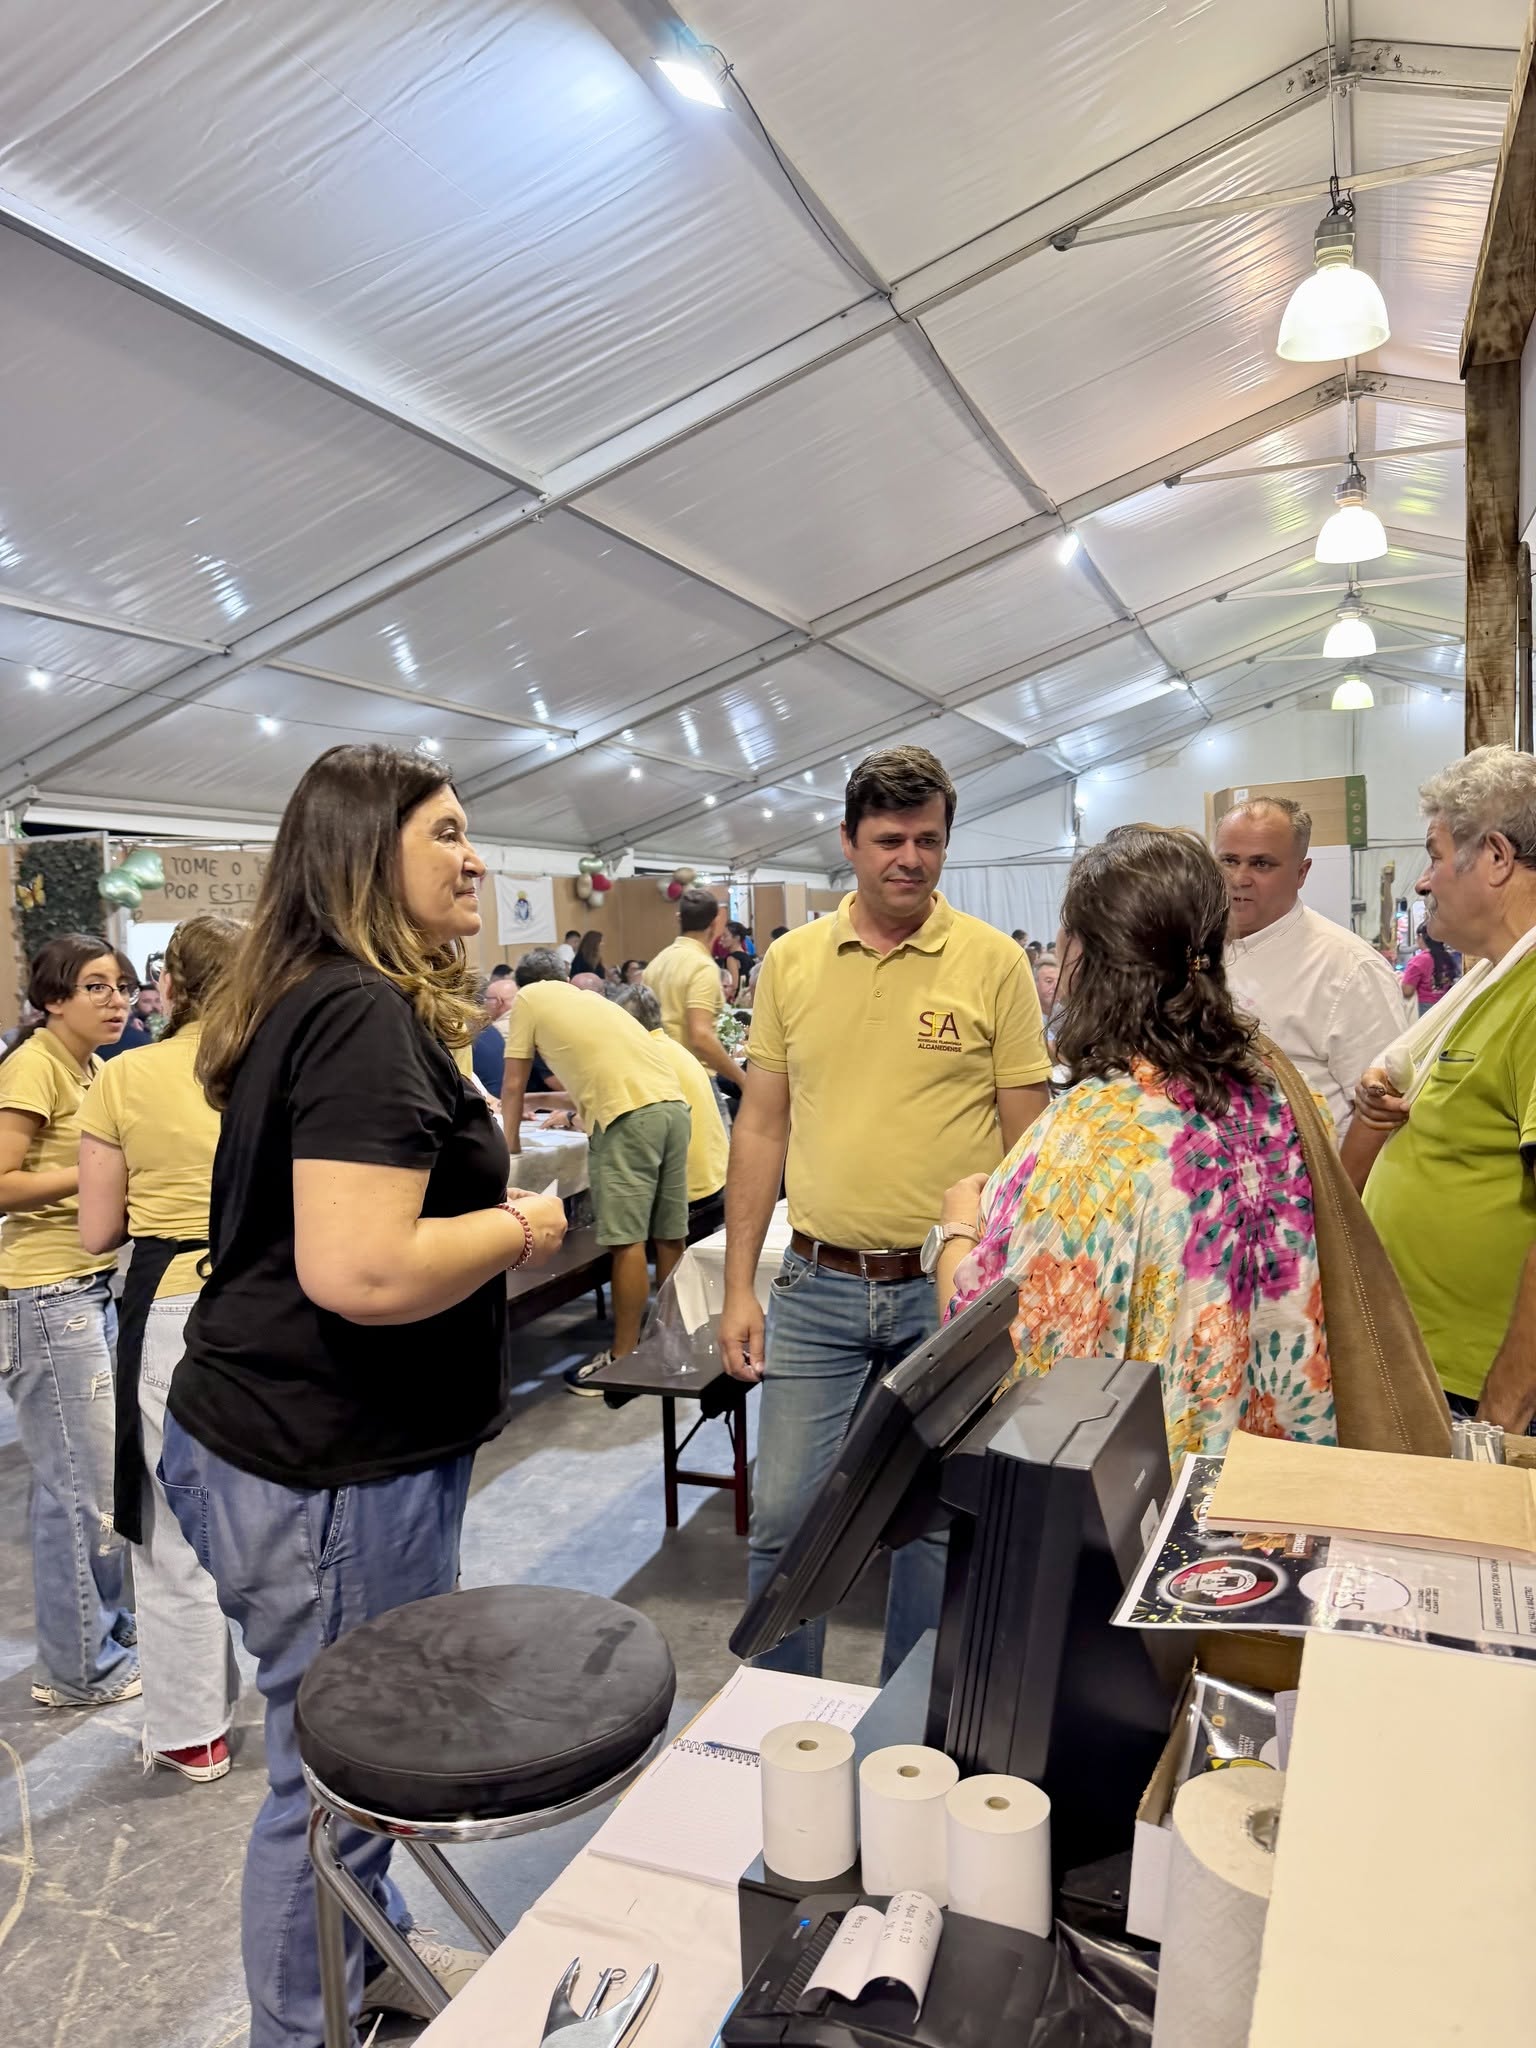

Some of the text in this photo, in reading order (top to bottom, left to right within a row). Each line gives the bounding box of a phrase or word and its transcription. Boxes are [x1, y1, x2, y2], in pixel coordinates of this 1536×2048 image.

[171, 856, 219, 877] TOME
[231, 861, 242, 876] O
[164, 882, 200, 899] POR
[918, 1043, 962, 1052] ALCANEDENSE
